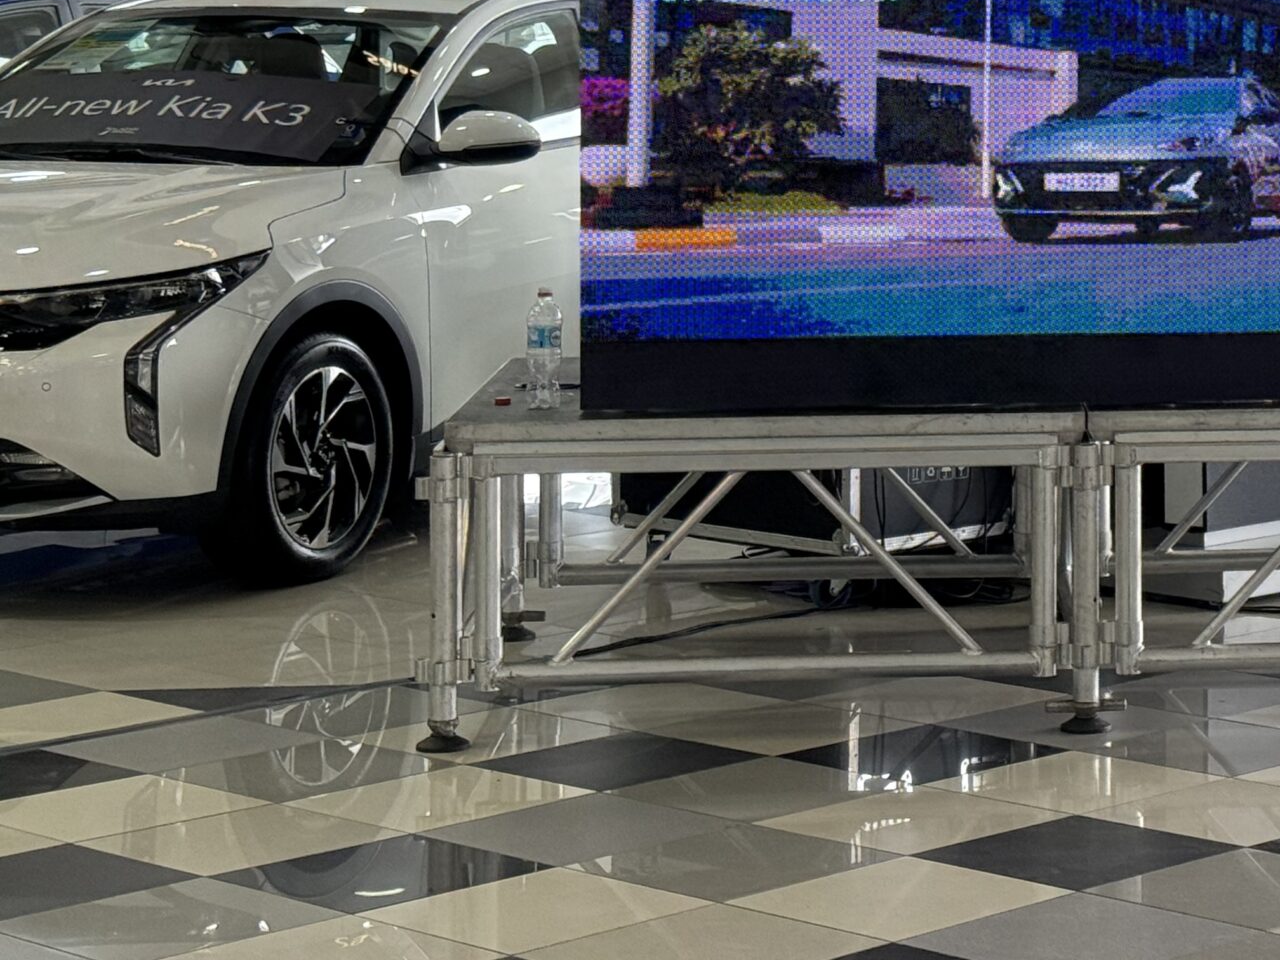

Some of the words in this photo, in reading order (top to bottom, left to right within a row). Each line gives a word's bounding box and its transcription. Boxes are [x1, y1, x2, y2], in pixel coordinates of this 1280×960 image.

[142, 78, 195, 87] KIA
[0, 95, 152, 120] All-new
[157, 94, 232, 121] Kia
[242, 100, 311, 127] K3
